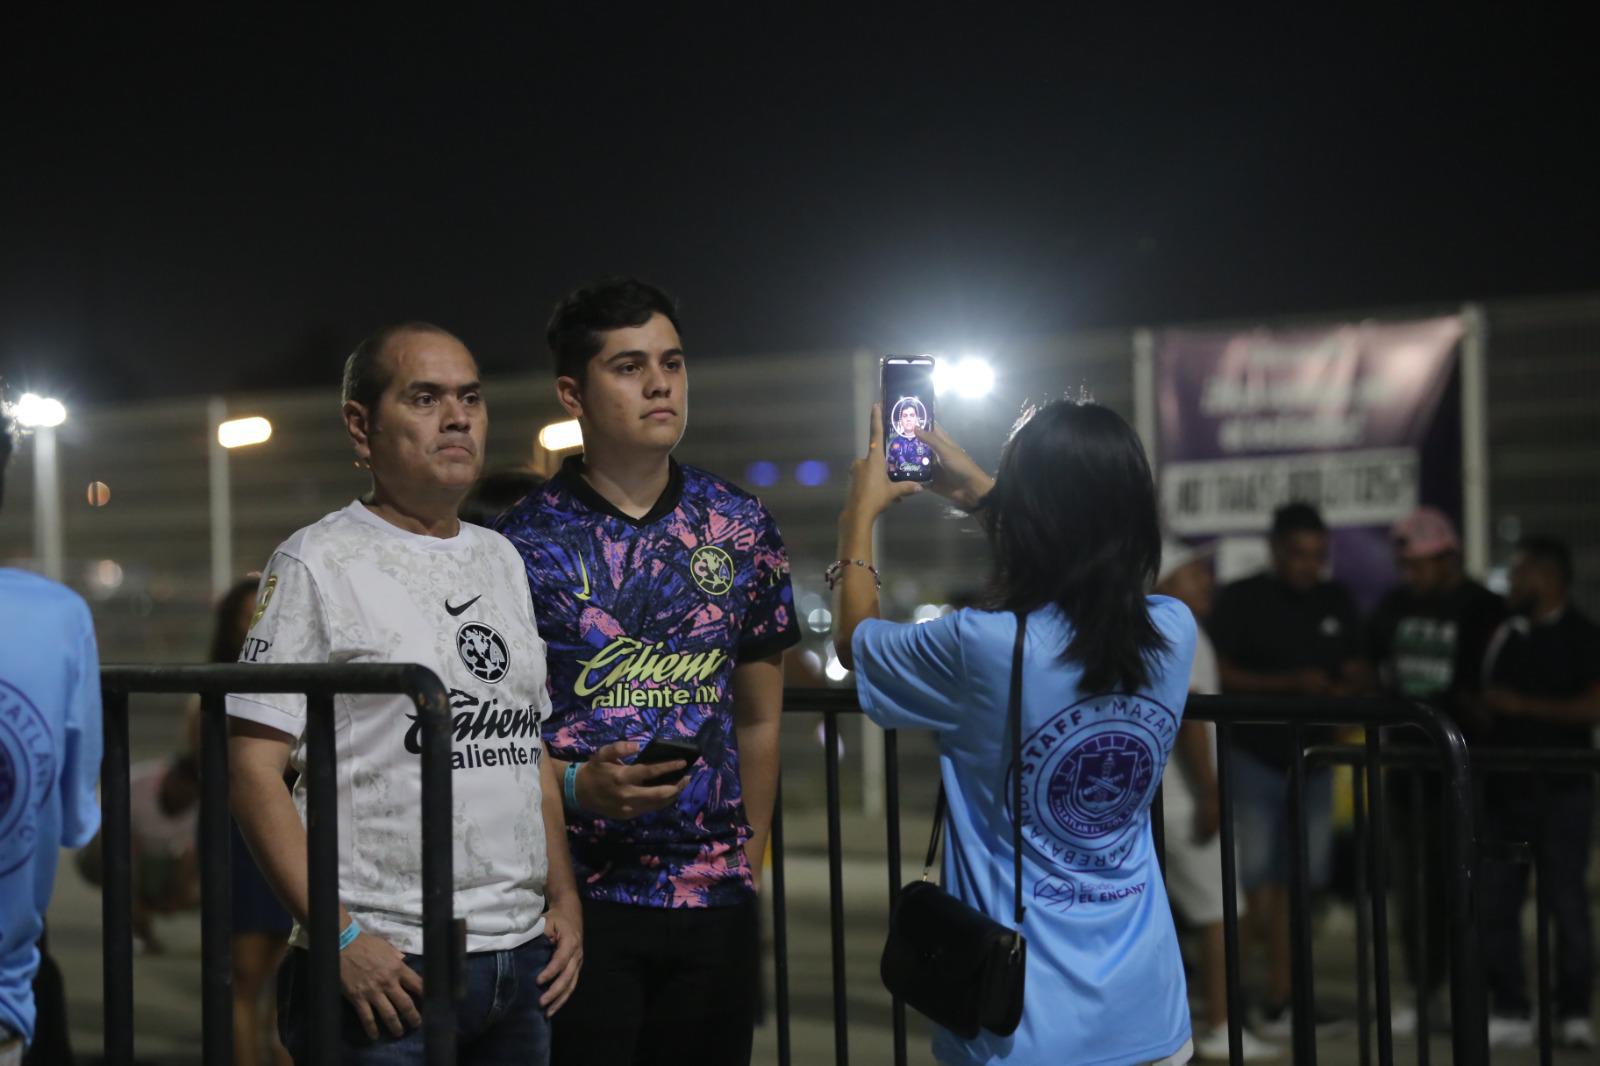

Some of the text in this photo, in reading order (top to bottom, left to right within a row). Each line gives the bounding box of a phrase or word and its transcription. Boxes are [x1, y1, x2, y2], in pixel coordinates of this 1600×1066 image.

[1022, 700, 1174, 775] STAFF MAZATL
[1079, 893, 1097, 904] EL
